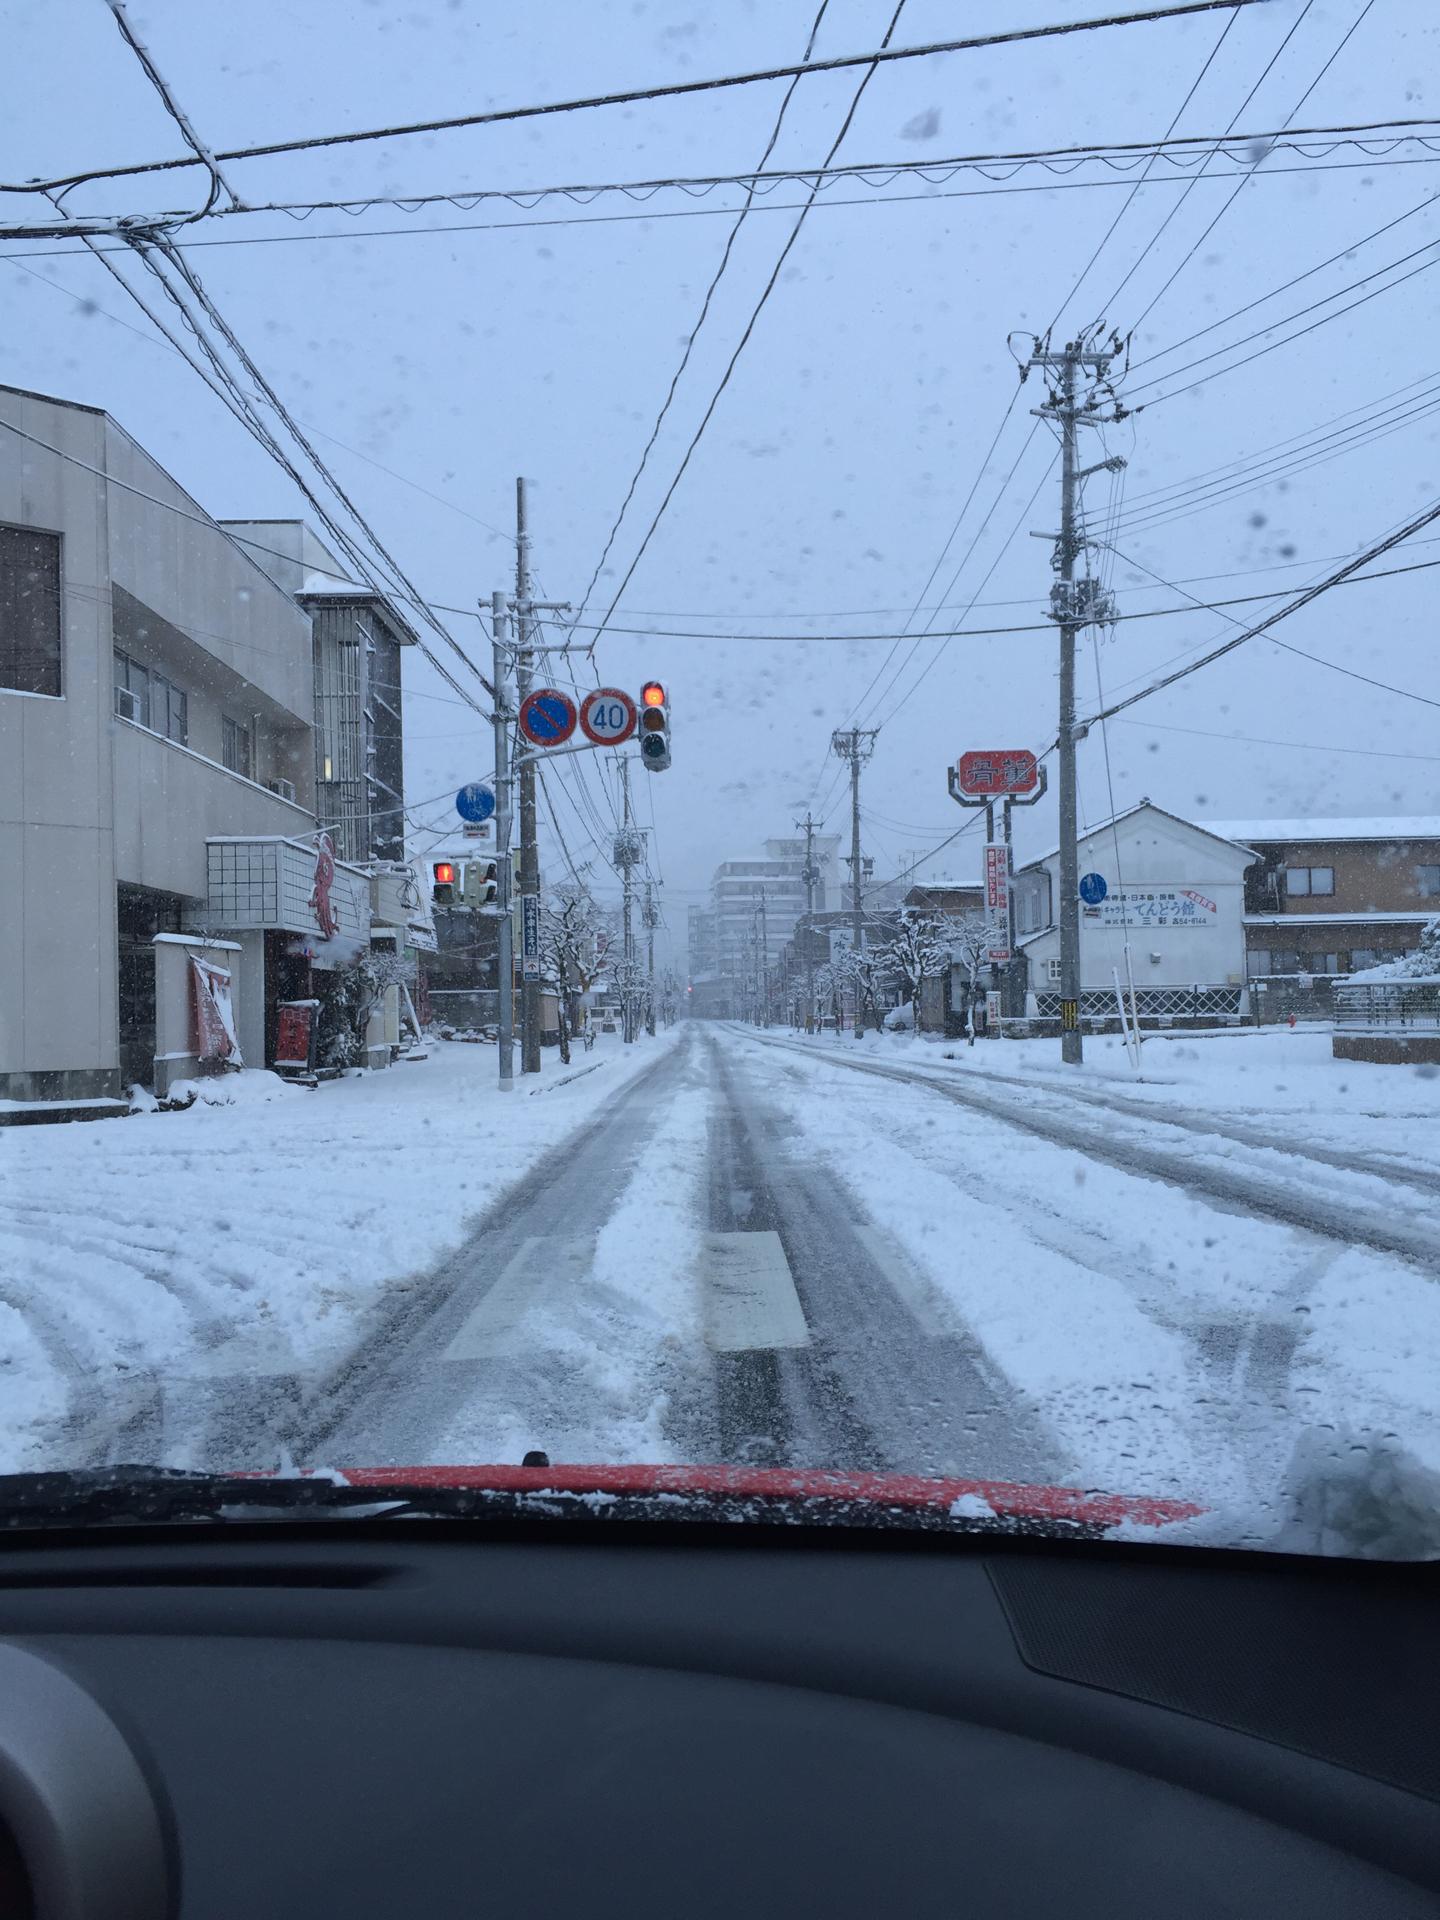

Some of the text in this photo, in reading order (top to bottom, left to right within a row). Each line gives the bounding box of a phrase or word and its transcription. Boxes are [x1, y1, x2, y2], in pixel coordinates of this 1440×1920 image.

[593, 704, 624, 730] 40
[1134, 901, 1195, 916] てんどう館
